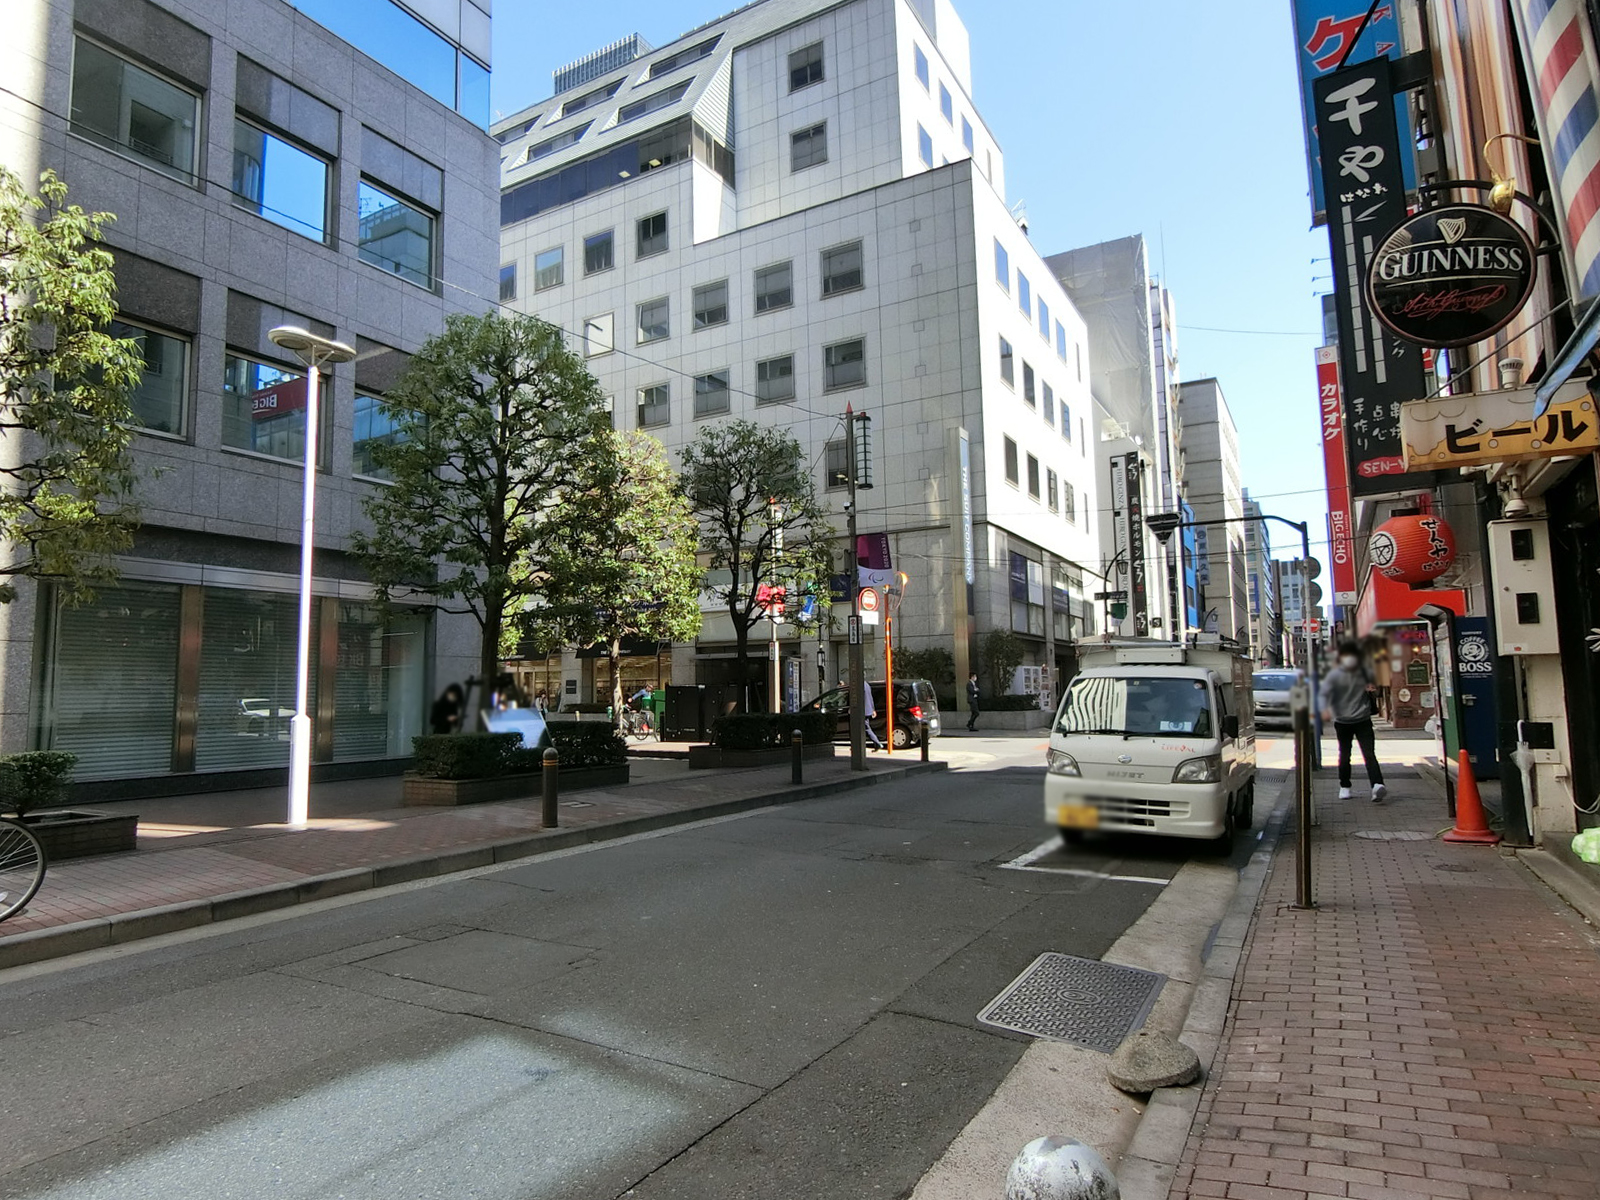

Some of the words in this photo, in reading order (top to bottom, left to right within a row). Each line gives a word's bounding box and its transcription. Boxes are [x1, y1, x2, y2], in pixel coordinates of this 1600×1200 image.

[1340, 182, 1388, 203] はなれ
[1379, 245, 1523, 280] GUINNESS
[1321, 383, 1341, 441] カラオケ
[1353, 397, 1368, 451] 手作り
[1445, 410, 1589, 454] ビール
[1331, 510, 1344, 532] BIG
[1420, 517, 1449, 558] せんや
[880, 537, 888, 555] TOKYO
[964, 524, 973, 584] COMPANY
[1335, 533, 1347, 564] ECHO
[1460, 636, 1486, 645] COFFEE
[1458, 661, 1493, 673] BOSS
